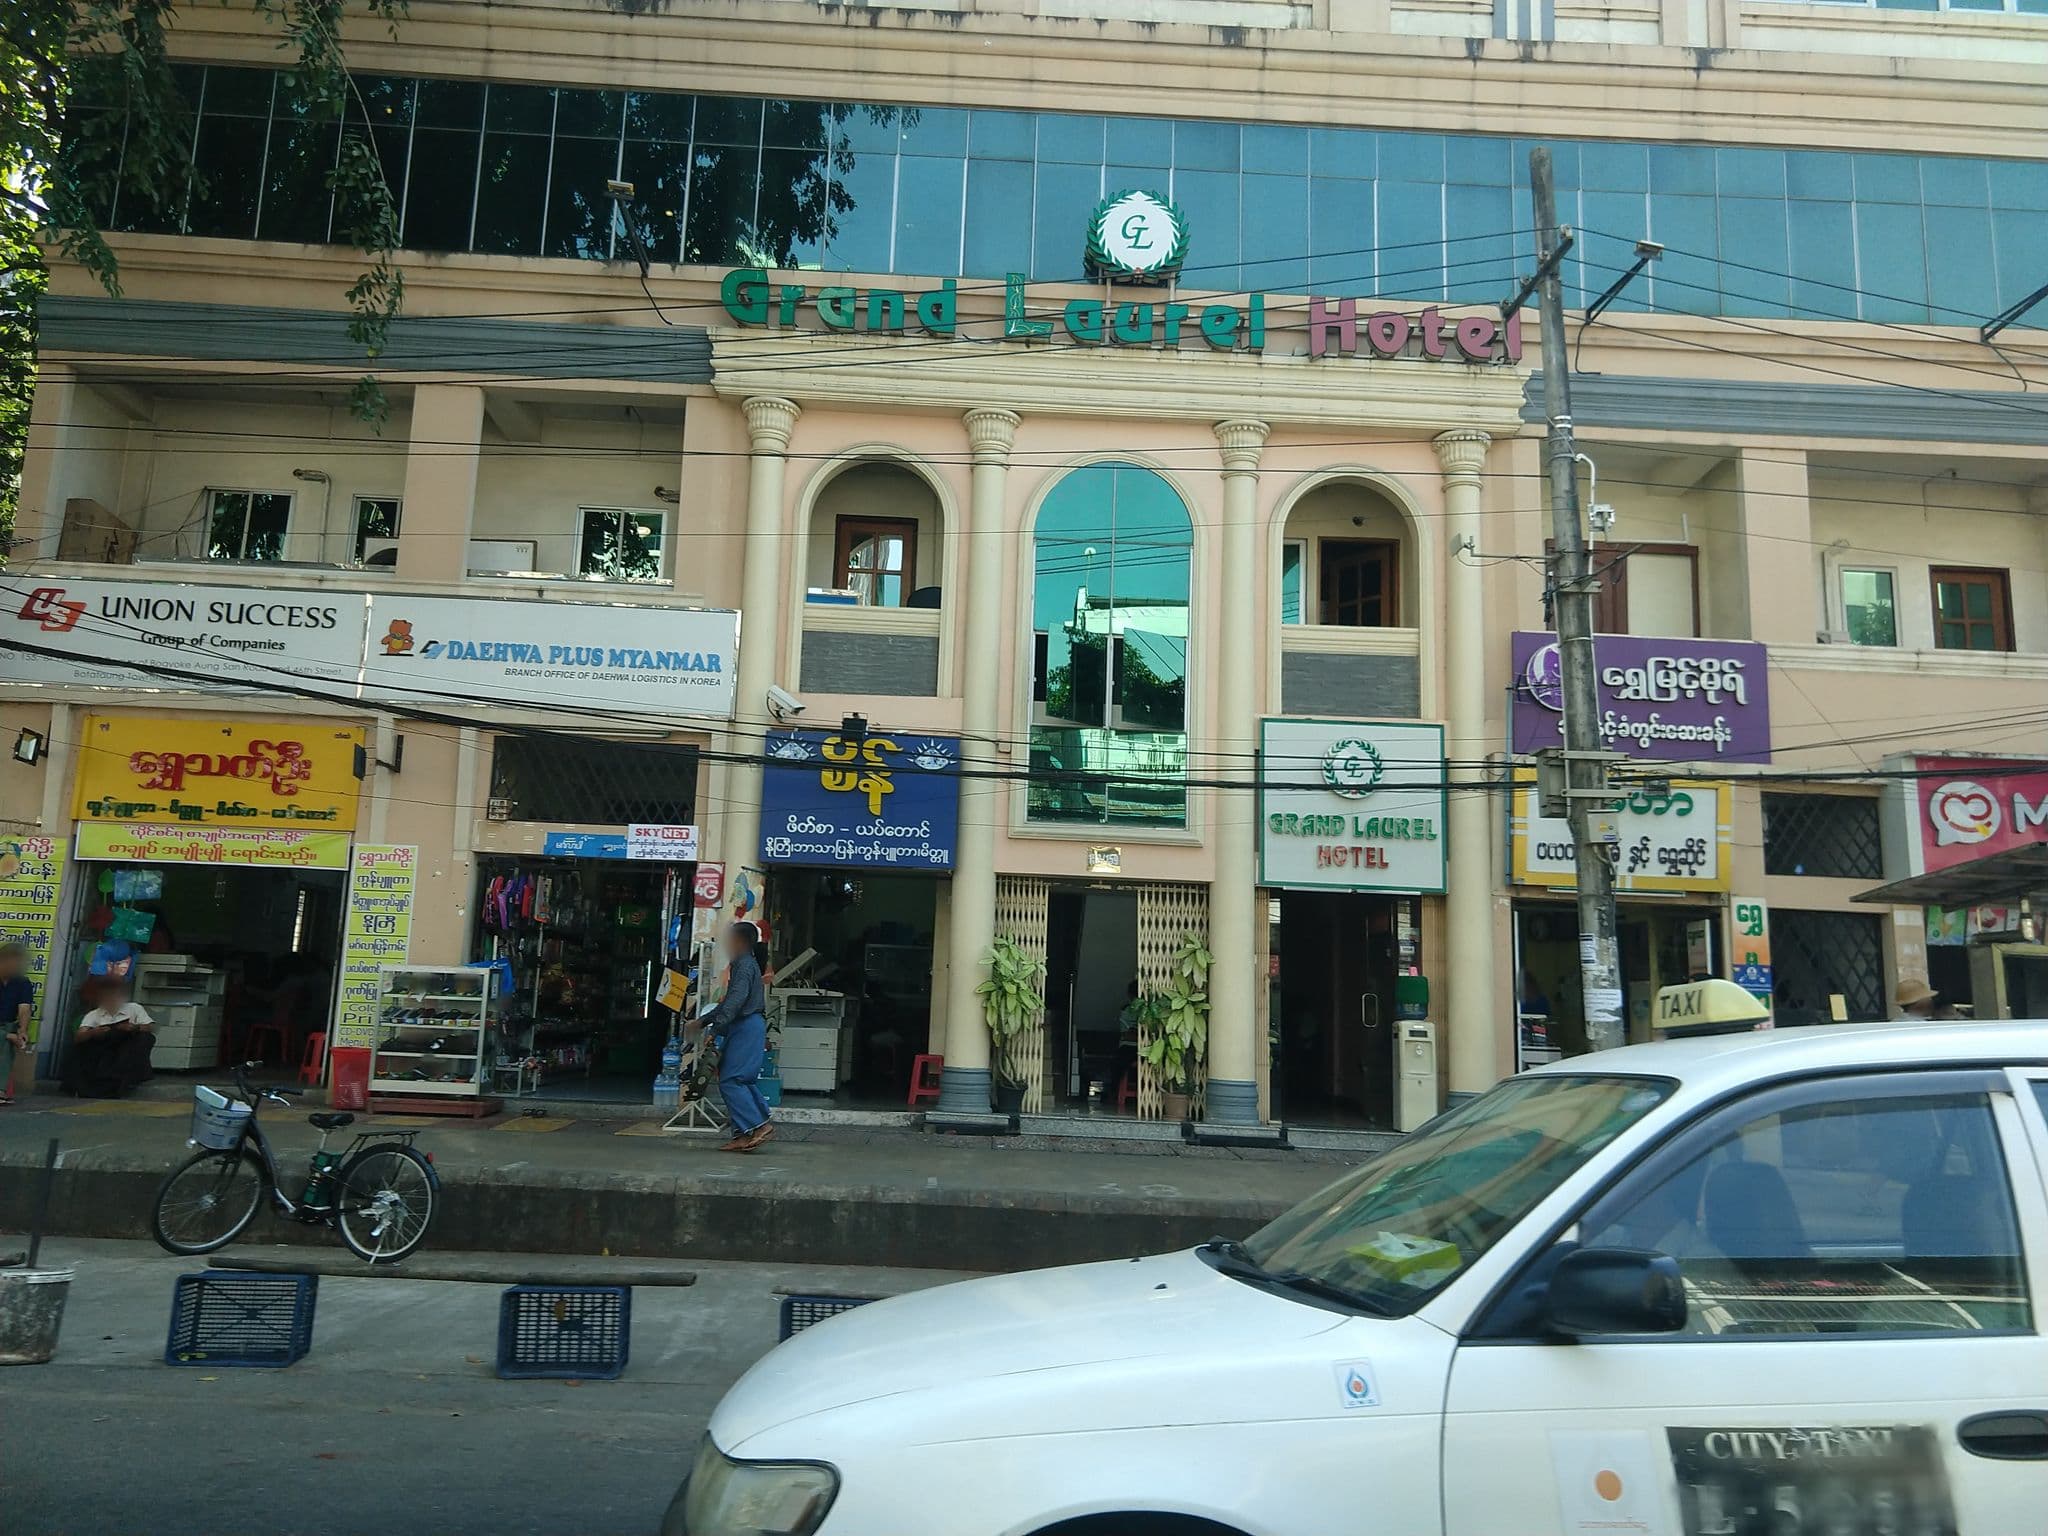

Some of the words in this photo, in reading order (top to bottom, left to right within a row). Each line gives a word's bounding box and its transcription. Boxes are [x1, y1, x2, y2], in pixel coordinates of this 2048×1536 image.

[721, 268, 957, 337] Grand
[1005, 273, 1265, 353] Laurel
[1309, 296, 1521, 365] Hotel
[101, 596, 195, 622] UNION
[208, 602, 338, 629] SUCCESS
[141, 632, 185, 649] Group
[191, 633, 206, 647] of
[210, 635, 286, 651] Companies
[194, 661, 219, 672] Aung
[223, 662, 241, 671] San
[447, 640, 542, 664] DAEHWA
[549, 645, 603, 666] PLUS
[608, 648, 722, 673] MYANMAR
[504, 668, 542, 678] BRANCH
[544, 669, 575, 679] OFFICE
[578, 671, 590, 680] OF
[592, 671, 629, 682] DAEHWA
[632, 673, 677, 685] LOGISTICS
[680, 676, 688, 685] IN
[690, 676, 721, 686] KOREA
[786, 815, 834, 834] ဖိတ်စာ
[855, 819, 930, 838] ယပ်တောင်
[1269, 813, 1345, 838] GRAND
[1352, 816, 1438, 840] LAUREL
[1317, 845, 1389, 869] HOTEL
[1660, 989, 1703, 1019] TAXI
[1704, 1431, 1788, 1459] CITY
